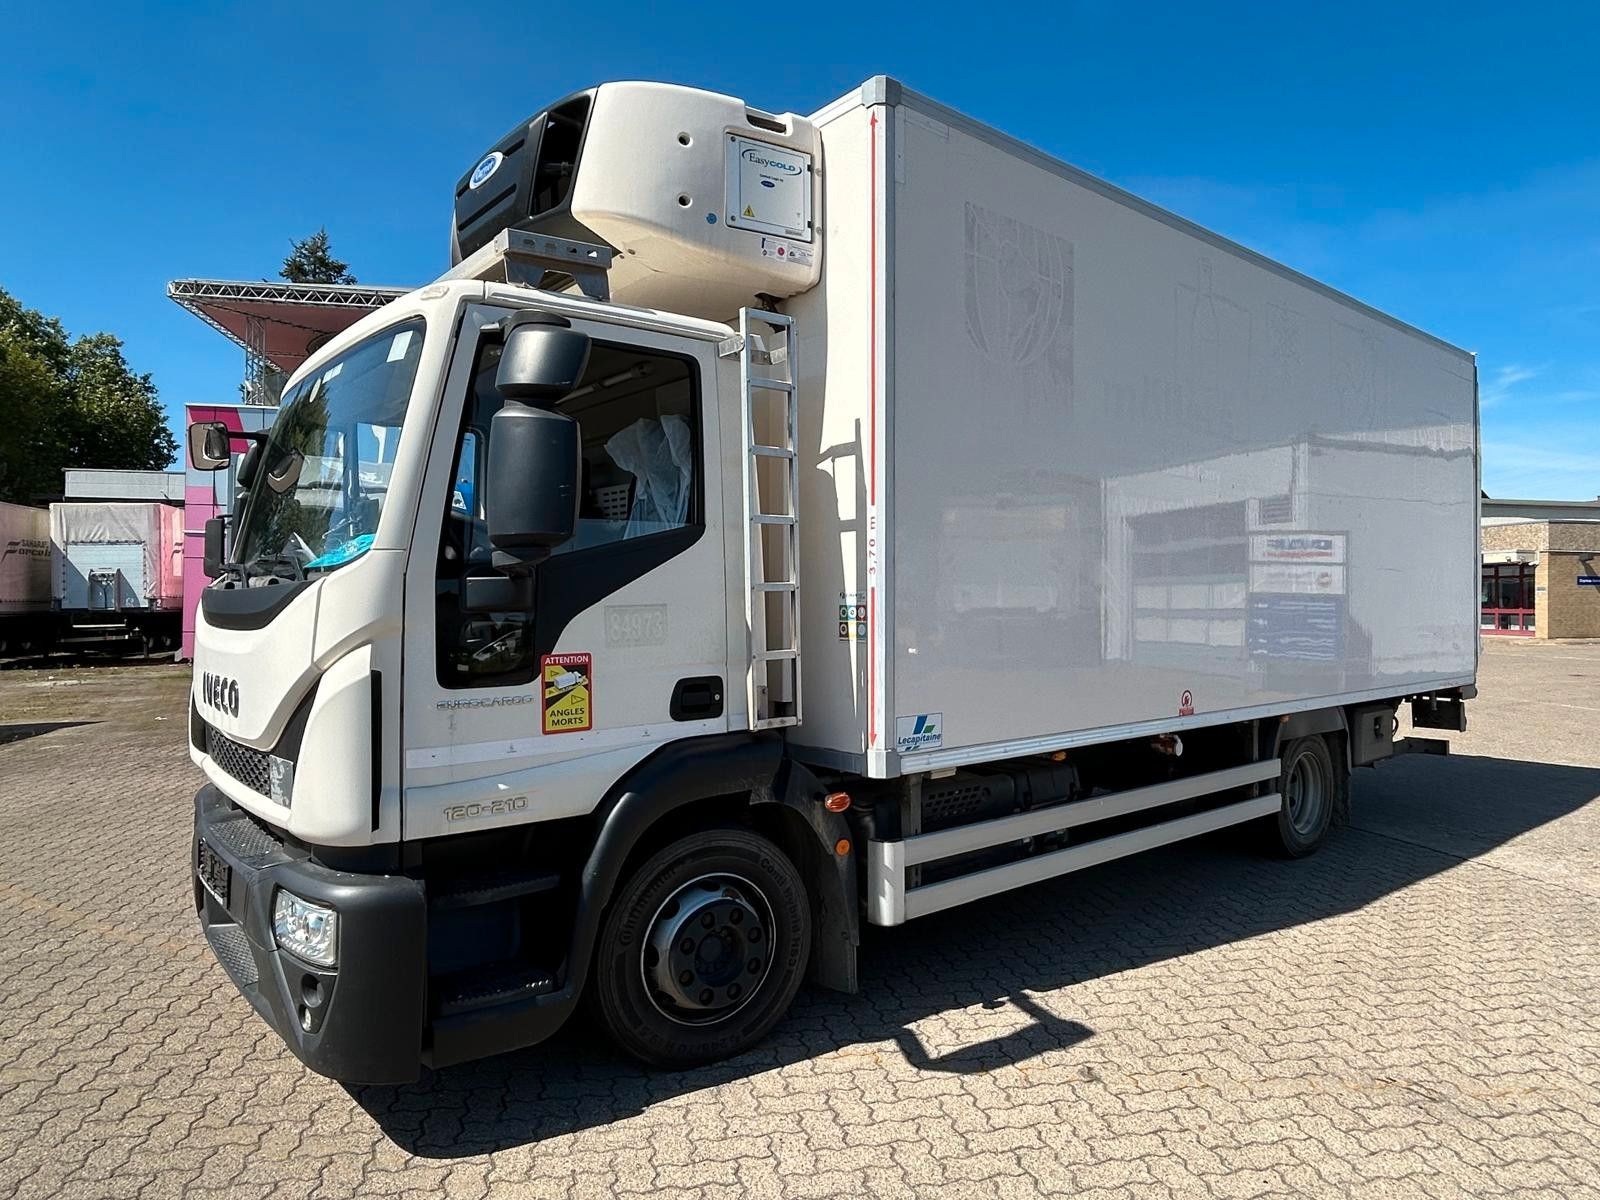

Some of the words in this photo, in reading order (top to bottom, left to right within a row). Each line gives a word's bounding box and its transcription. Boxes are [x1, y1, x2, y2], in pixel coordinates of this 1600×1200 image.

[544, 655, 589, 665] ATTENTION
[202, 671, 240, 719] IVECO
[436, 695, 535, 710] EUROCARGO
[550, 707, 585, 718] ANGLES
[551, 716, 584, 727] MORTS
[898, 733, 941, 745] Lecapitaine
[443, 796, 528, 822] 120-210
